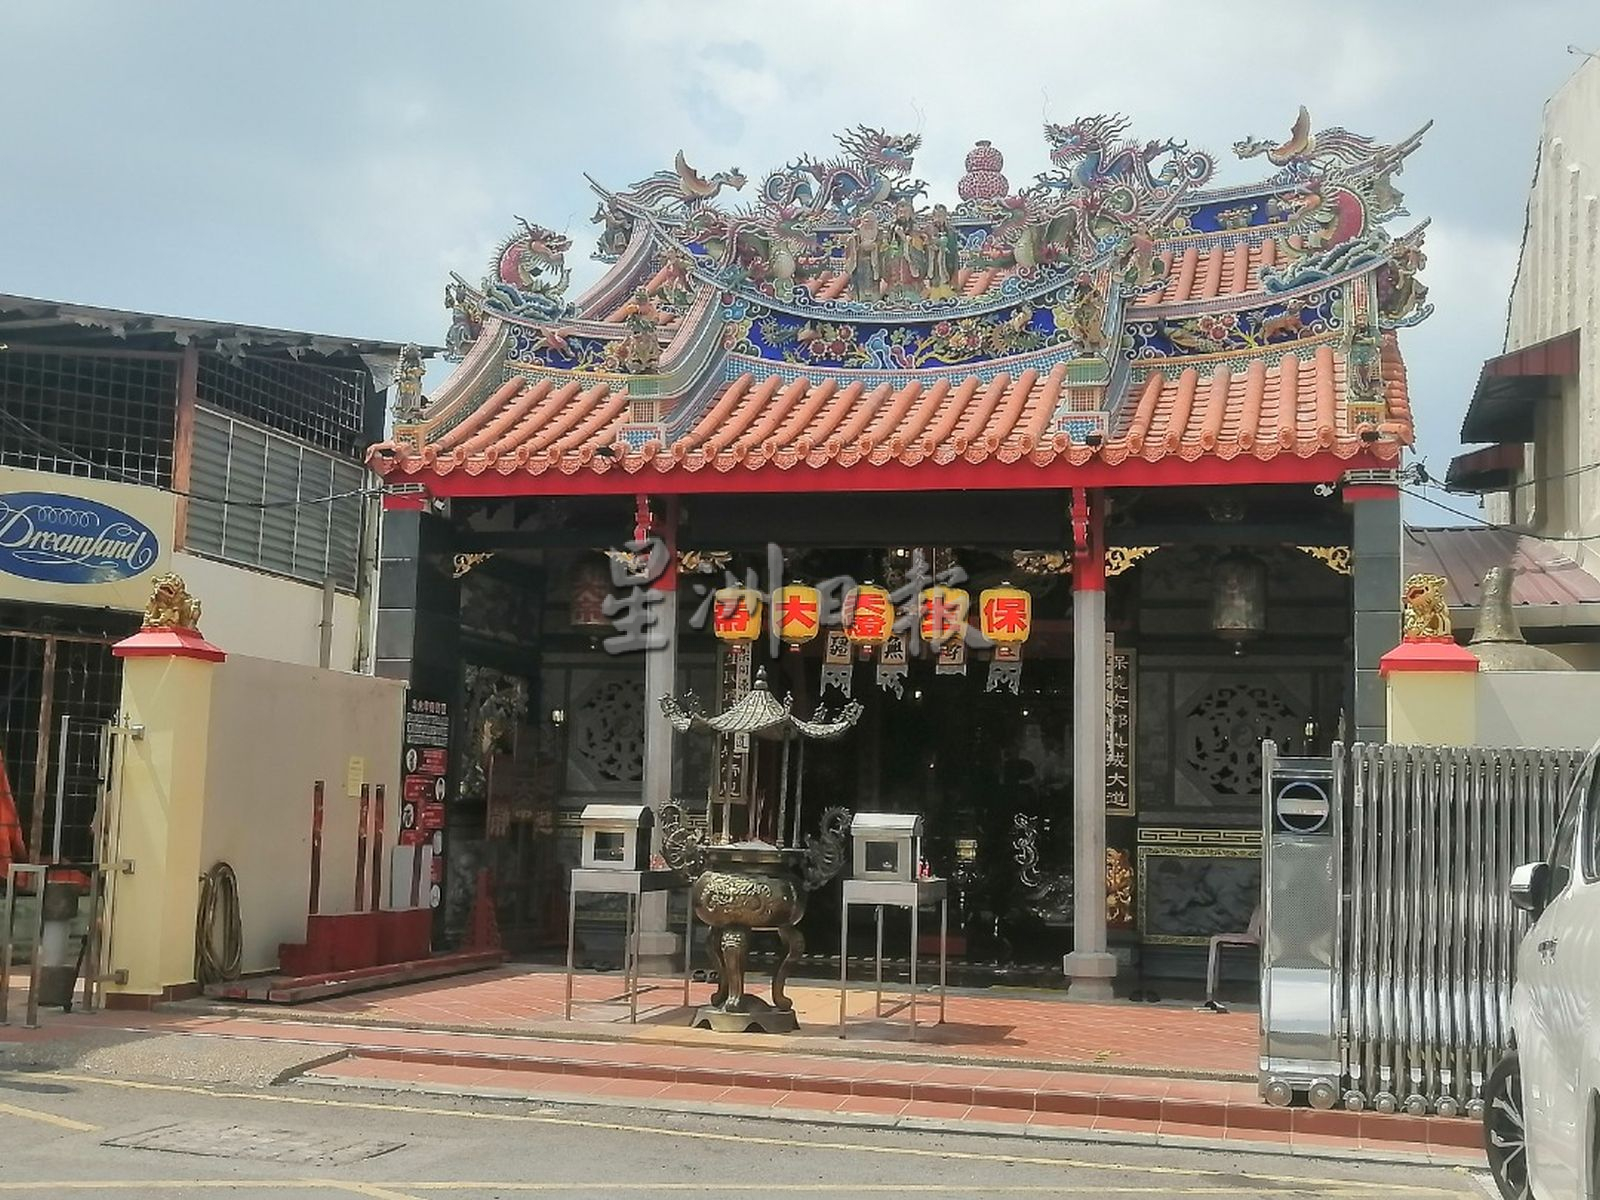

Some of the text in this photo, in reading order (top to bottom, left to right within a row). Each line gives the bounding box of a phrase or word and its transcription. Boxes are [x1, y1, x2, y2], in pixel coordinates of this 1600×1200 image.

[0, 502, 153, 570] Dreamland
[776, 595, 817, 629] 大
[984, 597, 1029, 633] 保
